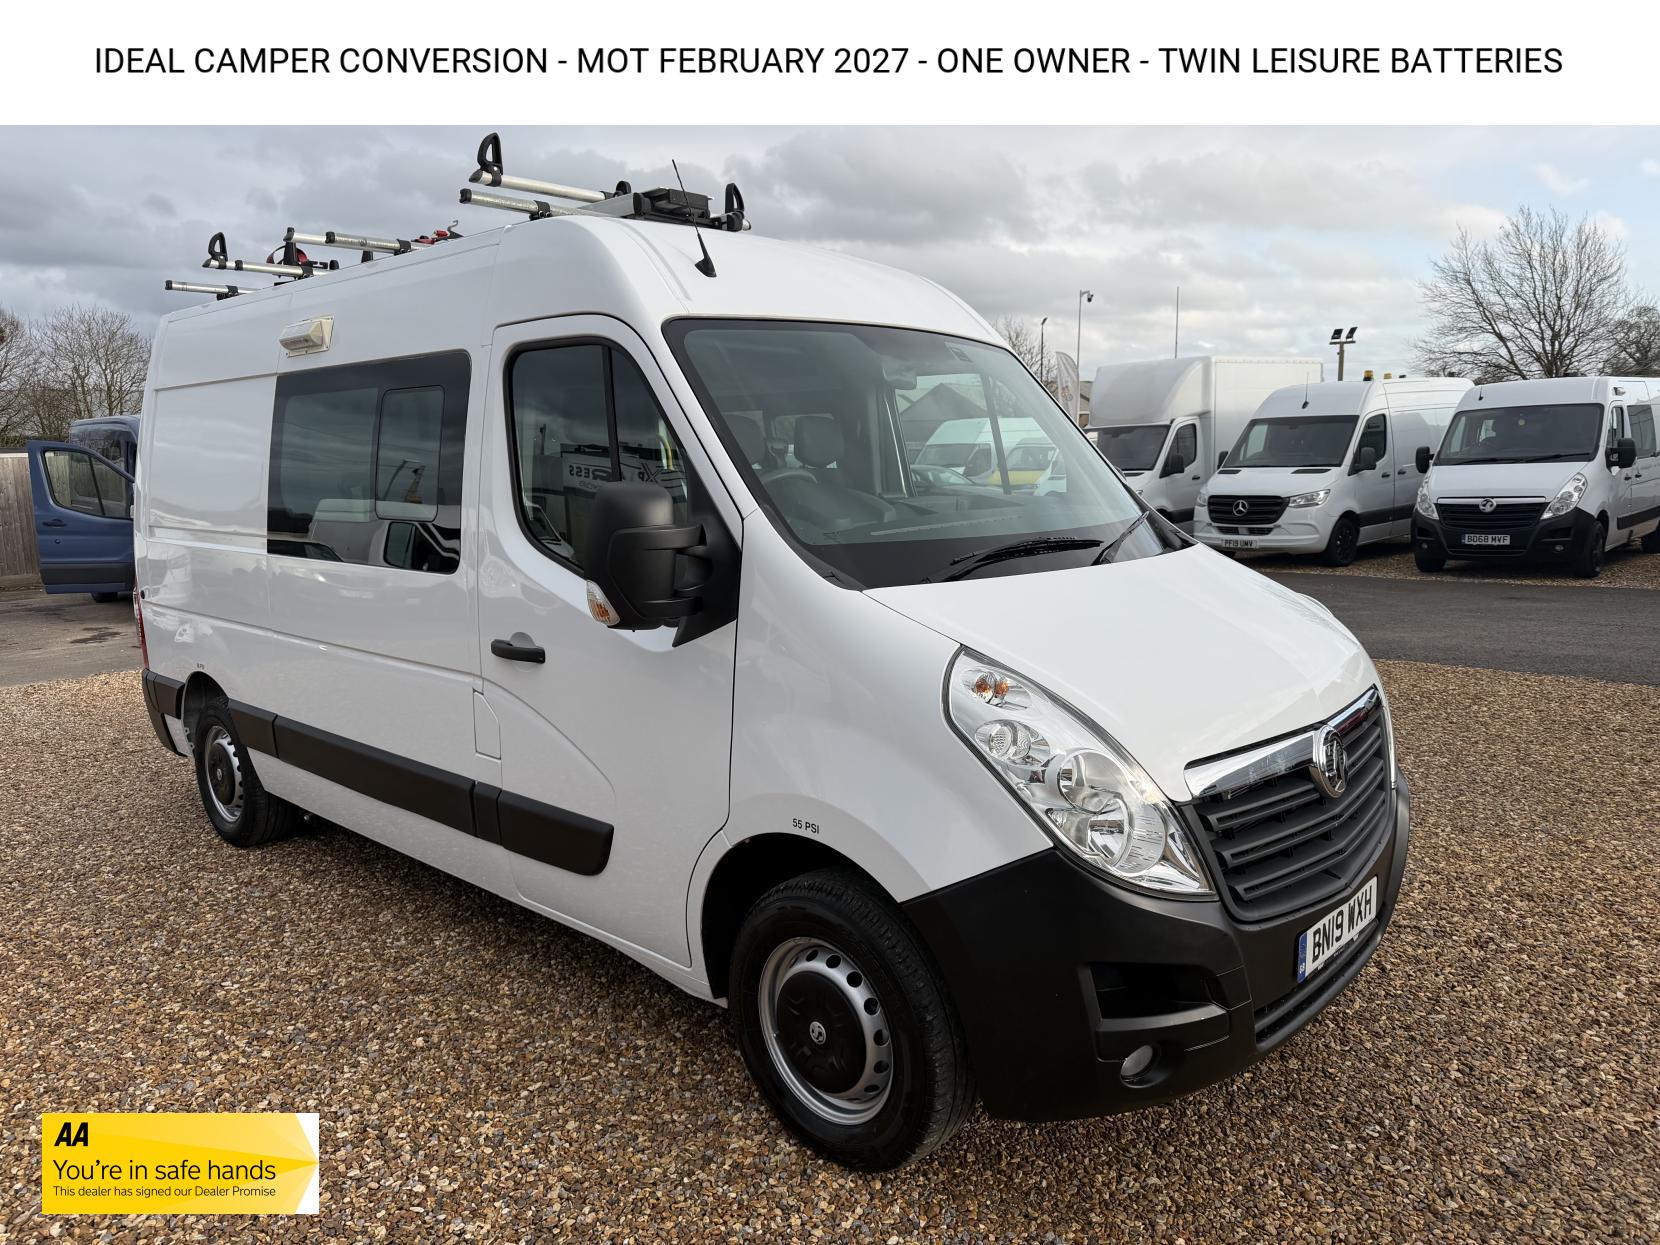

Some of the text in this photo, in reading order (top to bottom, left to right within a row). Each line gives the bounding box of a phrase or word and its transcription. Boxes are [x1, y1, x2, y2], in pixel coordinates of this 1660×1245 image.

[1467, 535, 1489, 543] BD68
[792, 818, 820, 834] 55 PSI
[1312, 885, 1372, 964] BN19 WXH
